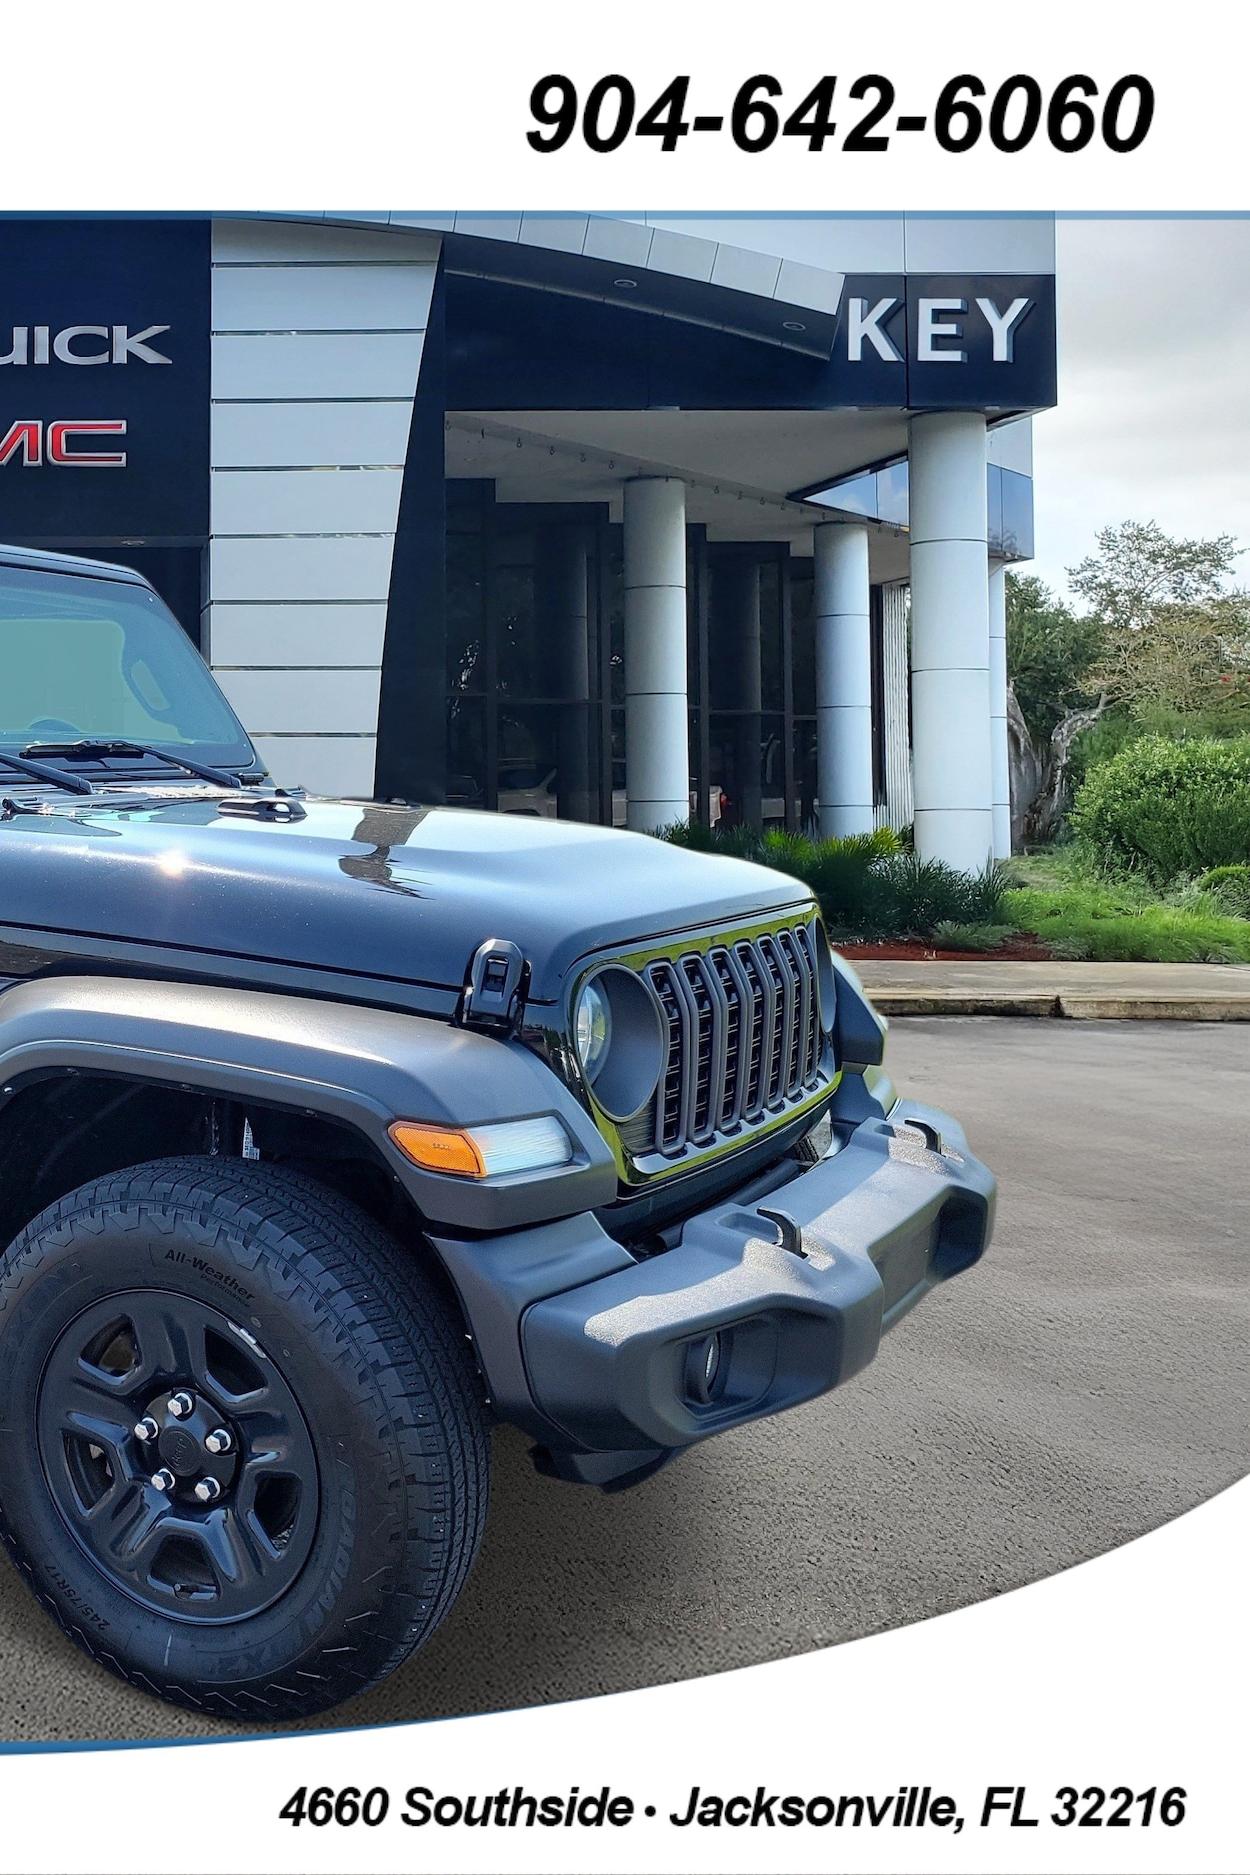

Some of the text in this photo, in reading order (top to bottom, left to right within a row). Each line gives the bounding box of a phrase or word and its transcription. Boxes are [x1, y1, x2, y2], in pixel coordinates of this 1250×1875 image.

[847, 297, 1036, 363] KEY
[164, 1248, 256, 1301] All-Weather
[43, 1565, 111, 1630] 245/75R17
